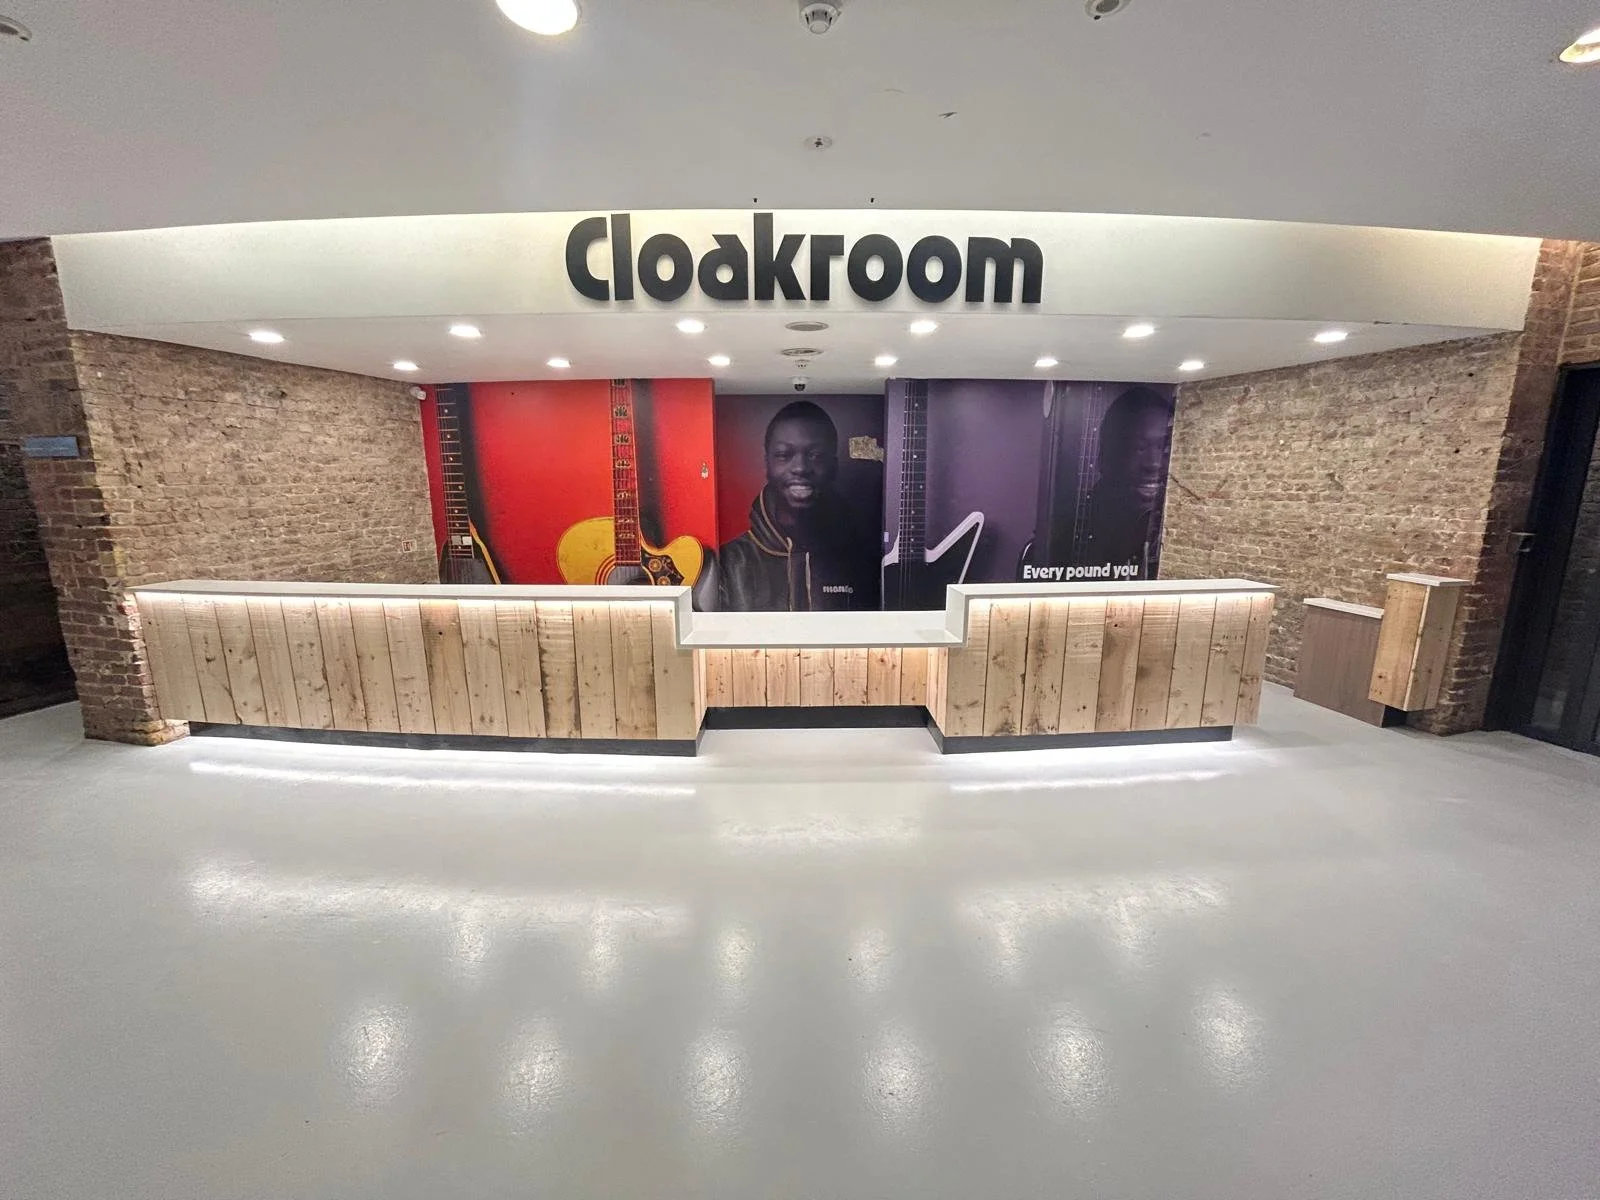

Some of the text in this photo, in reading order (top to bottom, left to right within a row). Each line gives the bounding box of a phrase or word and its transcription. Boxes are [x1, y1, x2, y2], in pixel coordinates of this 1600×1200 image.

[565, 212, 1044, 304] Cloakroom
[1023, 562, 1139, 581] Every pound you
